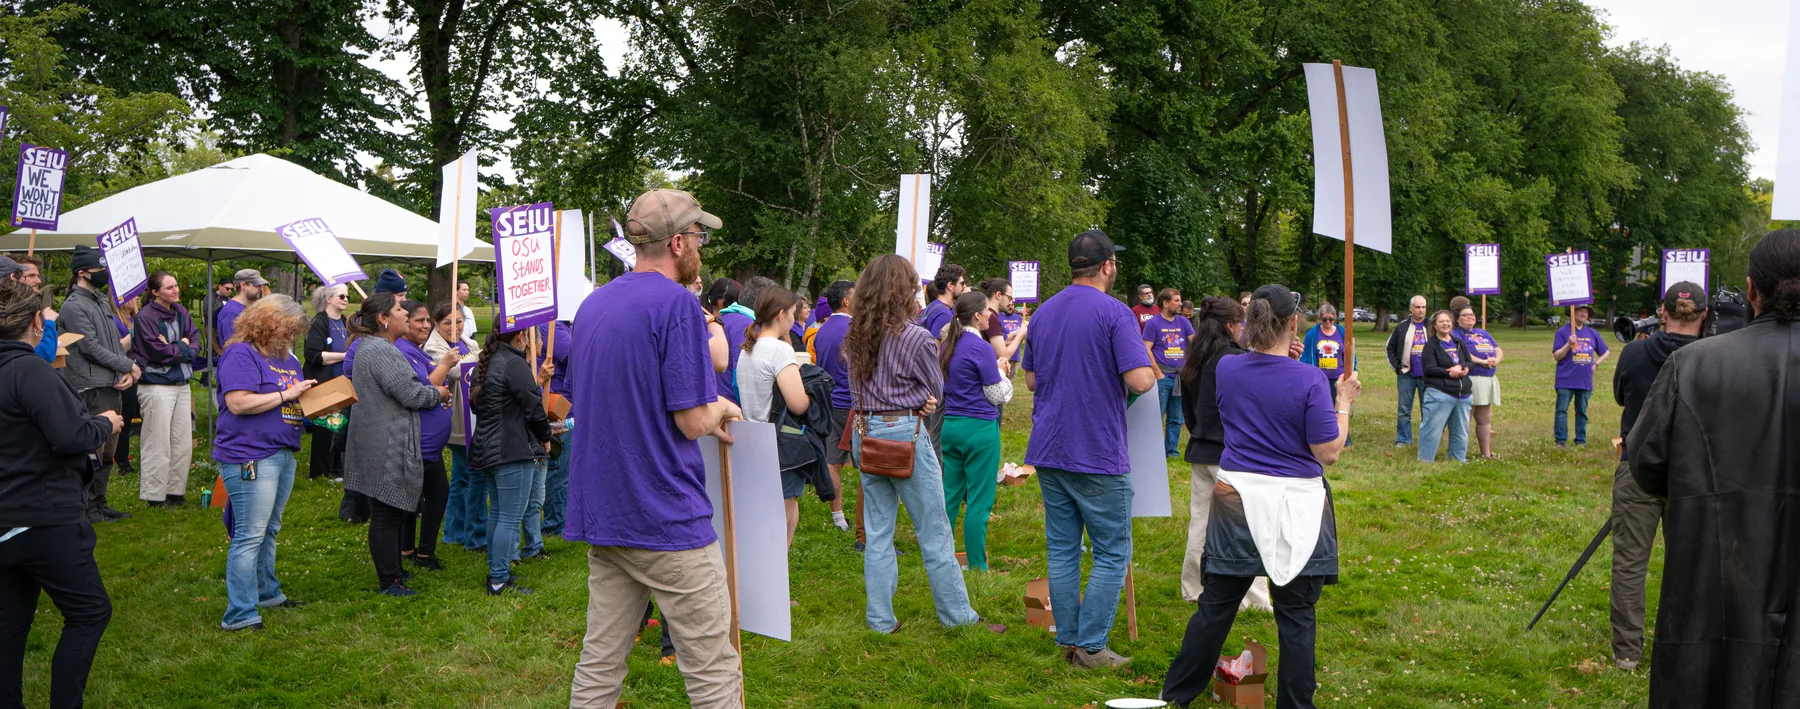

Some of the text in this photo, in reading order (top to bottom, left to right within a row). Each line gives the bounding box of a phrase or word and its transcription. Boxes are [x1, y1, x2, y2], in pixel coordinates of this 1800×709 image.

[24, 147, 66, 170] SEIU
[28, 166, 52, 188] WE
[21, 186, 58, 205] WON'T
[17, 199, 55, 219] STOP!
[282, 219, 327, 240] SEIU
[499, 207, 549, 237] SEIU
[101, 220, 135, 251] SEIU
[511, 237, 540, 257] OSU
[926, 243, 943, 255] EIU
[1468, 245, 1497, 256] SEIU
[1666, 250, 1706, 262] SEIU
[1011, 262, 1038, 271] SEIU
[1549, 252, 1585, 267] SEIU
[507, 277, 551, 300] TOGETHER
